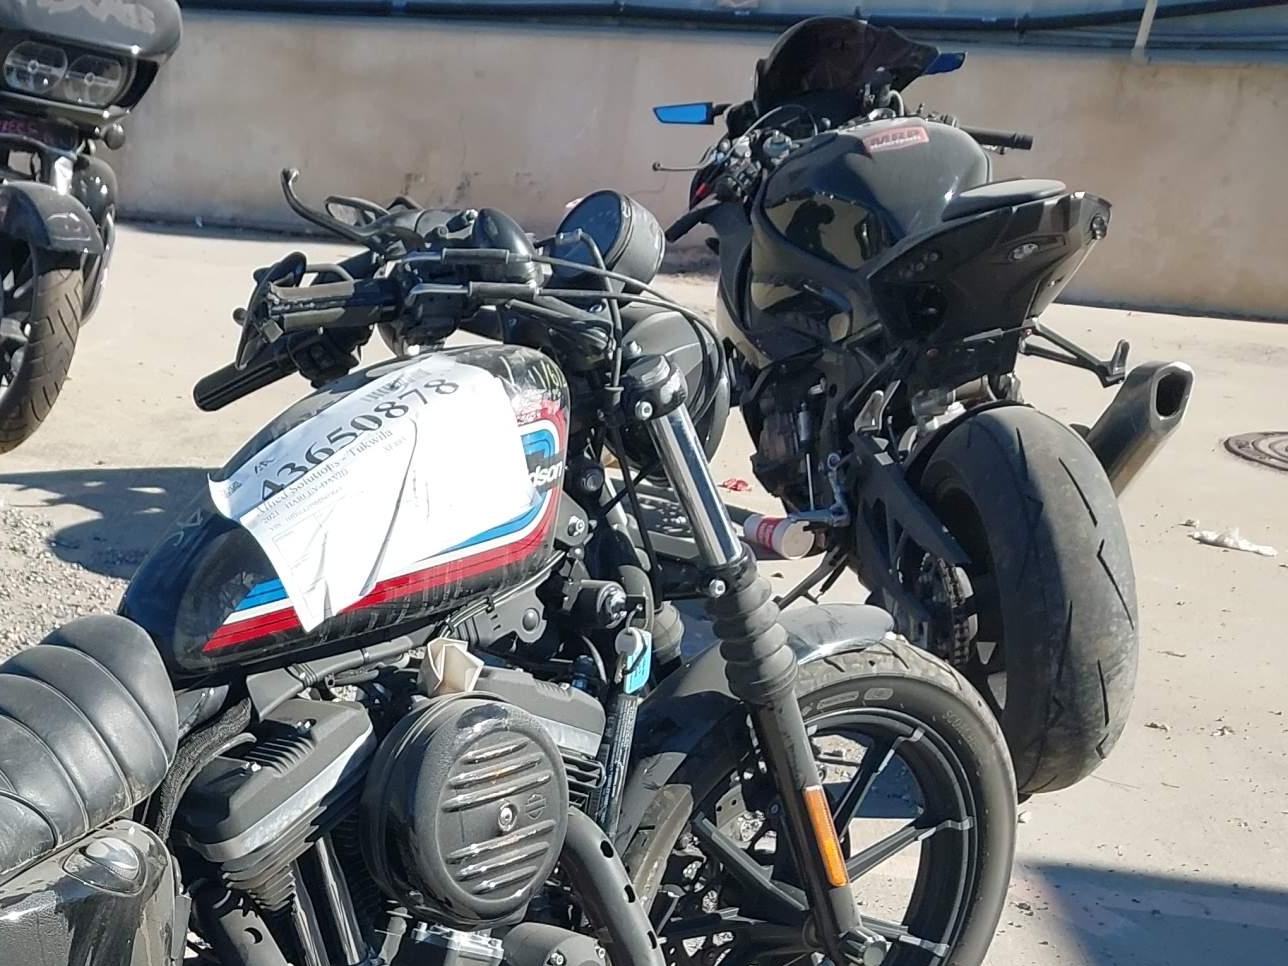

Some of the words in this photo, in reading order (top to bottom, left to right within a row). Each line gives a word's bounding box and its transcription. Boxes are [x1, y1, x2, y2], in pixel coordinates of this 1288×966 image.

[260, 378, 459, 501] 43650878
[347, 428, 394, 460] Tukwila
[529, 461, 564, 487] dson
